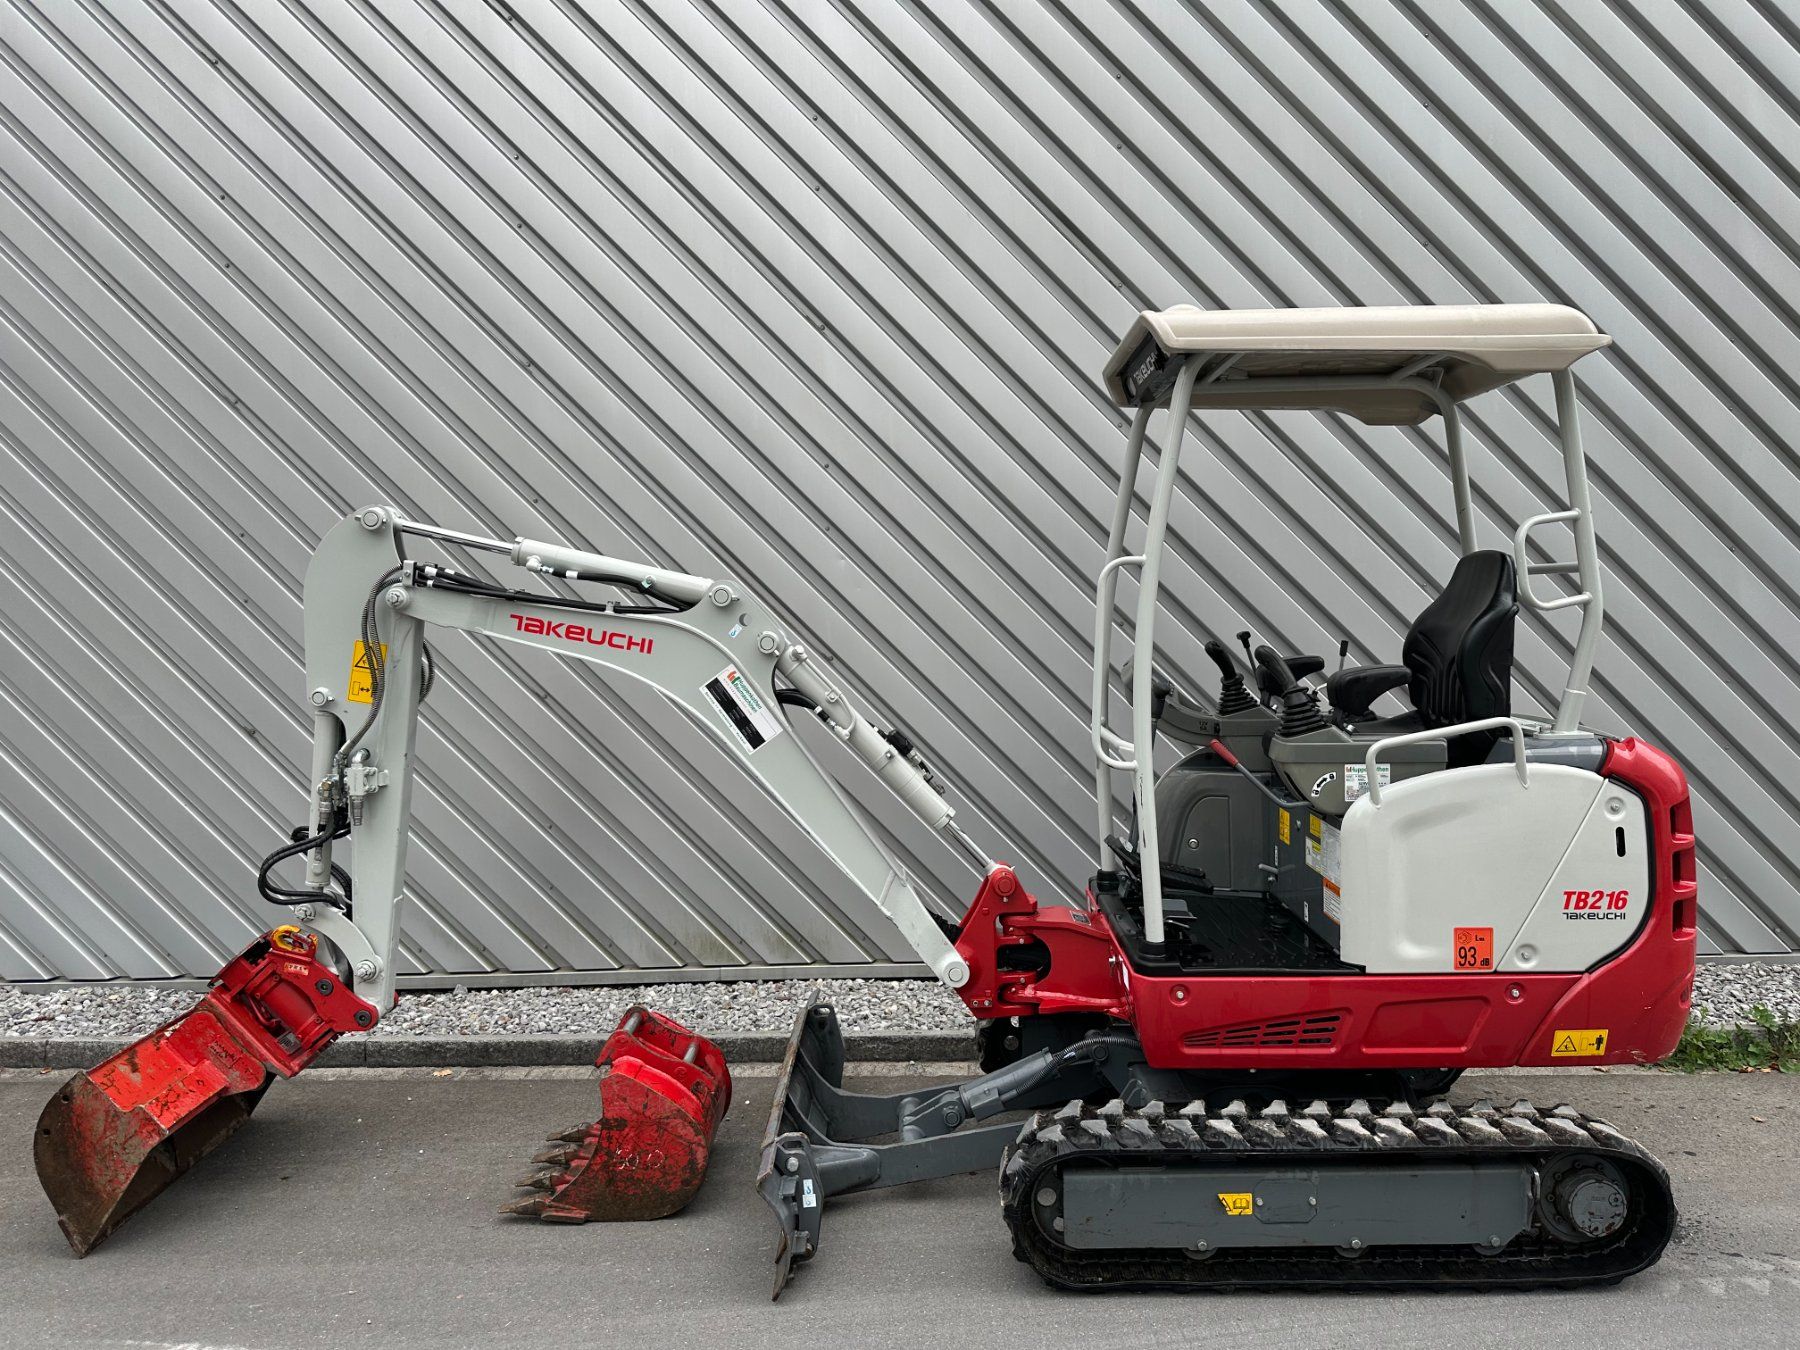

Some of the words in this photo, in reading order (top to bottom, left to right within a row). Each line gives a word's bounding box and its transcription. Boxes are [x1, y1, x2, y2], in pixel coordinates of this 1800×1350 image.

[510, 614, 653, 654] TAKEUCHI
[1563, 890, 1629, 910] TB216
[1562, 912, 1626, 920] TAKEUCHI
[1458, 946, 1477, 967] 93
[1480, 957, 1490, 966] dB
